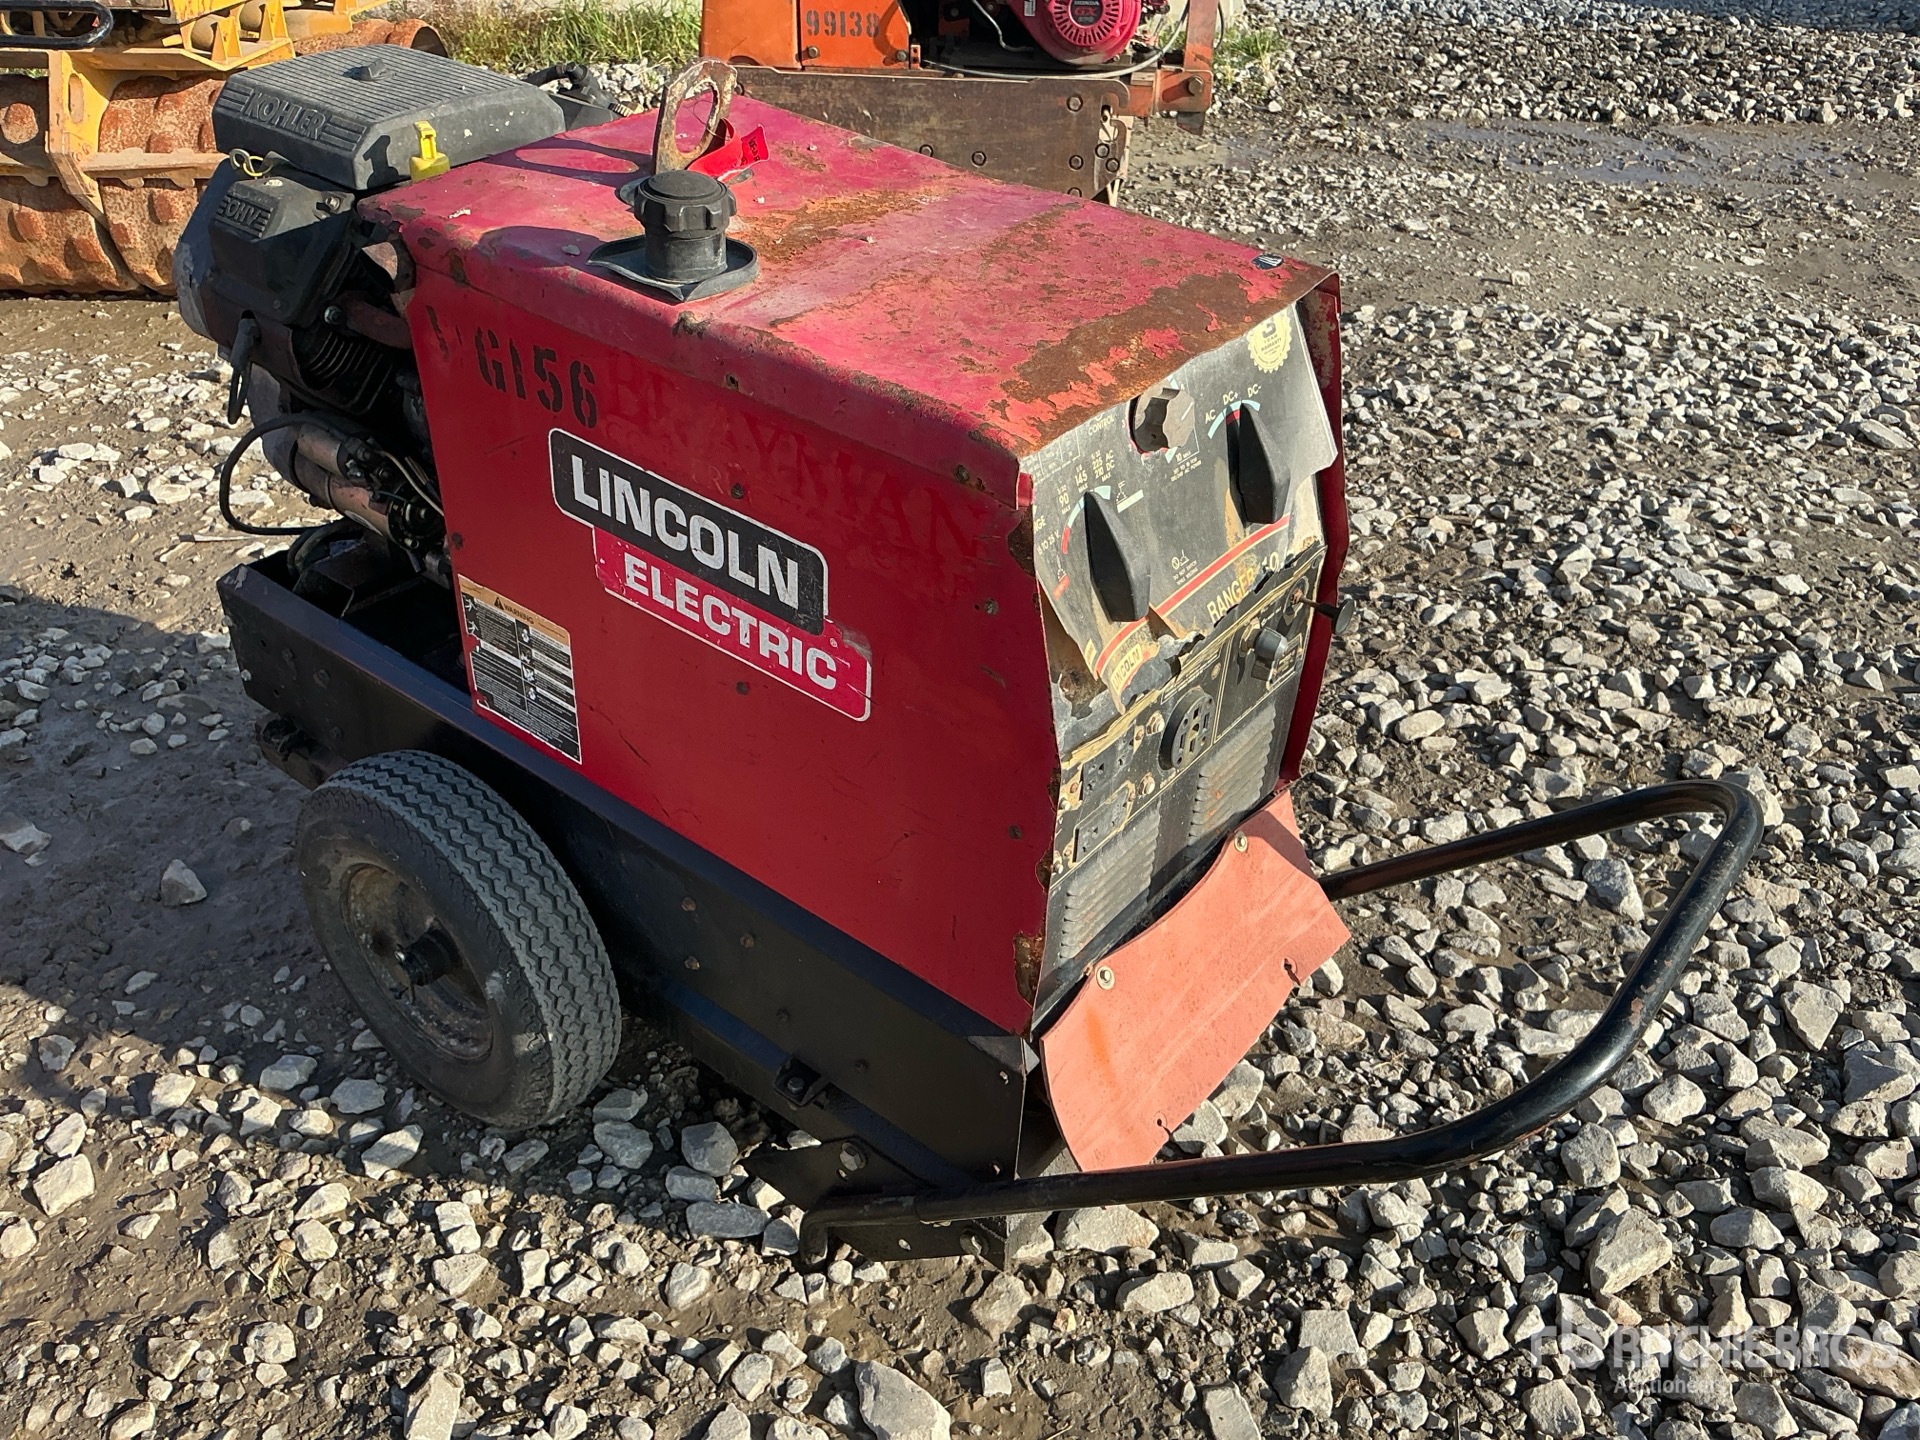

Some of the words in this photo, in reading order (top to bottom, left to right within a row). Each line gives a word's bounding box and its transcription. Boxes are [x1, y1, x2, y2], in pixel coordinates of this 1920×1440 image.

[806, 10, 880, 38] 99138
[246, 90, 327, 140] KOHLER
[226, 200, 261, 225] OHV
[1205, 409, 1216, 424] AC
[1223, 391, 1238, 405] DC+
[1247, 383, 1261, 398] DC-
[1088, 414, 1115, 436] CONTROL
[1105, 449, 1114, 461] AC
[1105, 460, 1115, 471] DC
[1074, 470, 1088, 486] 145
[1058, 493, 1069, 507] 90
[572, 453, 799, 610] LINCOLN
[1206, 568, 1254, 623] RANGER
[503, 603, 534, 625] WARNING
[624, 552, 837, 690] ELECTRIC
[1112, 648, 1140, 690] LINCOLN
